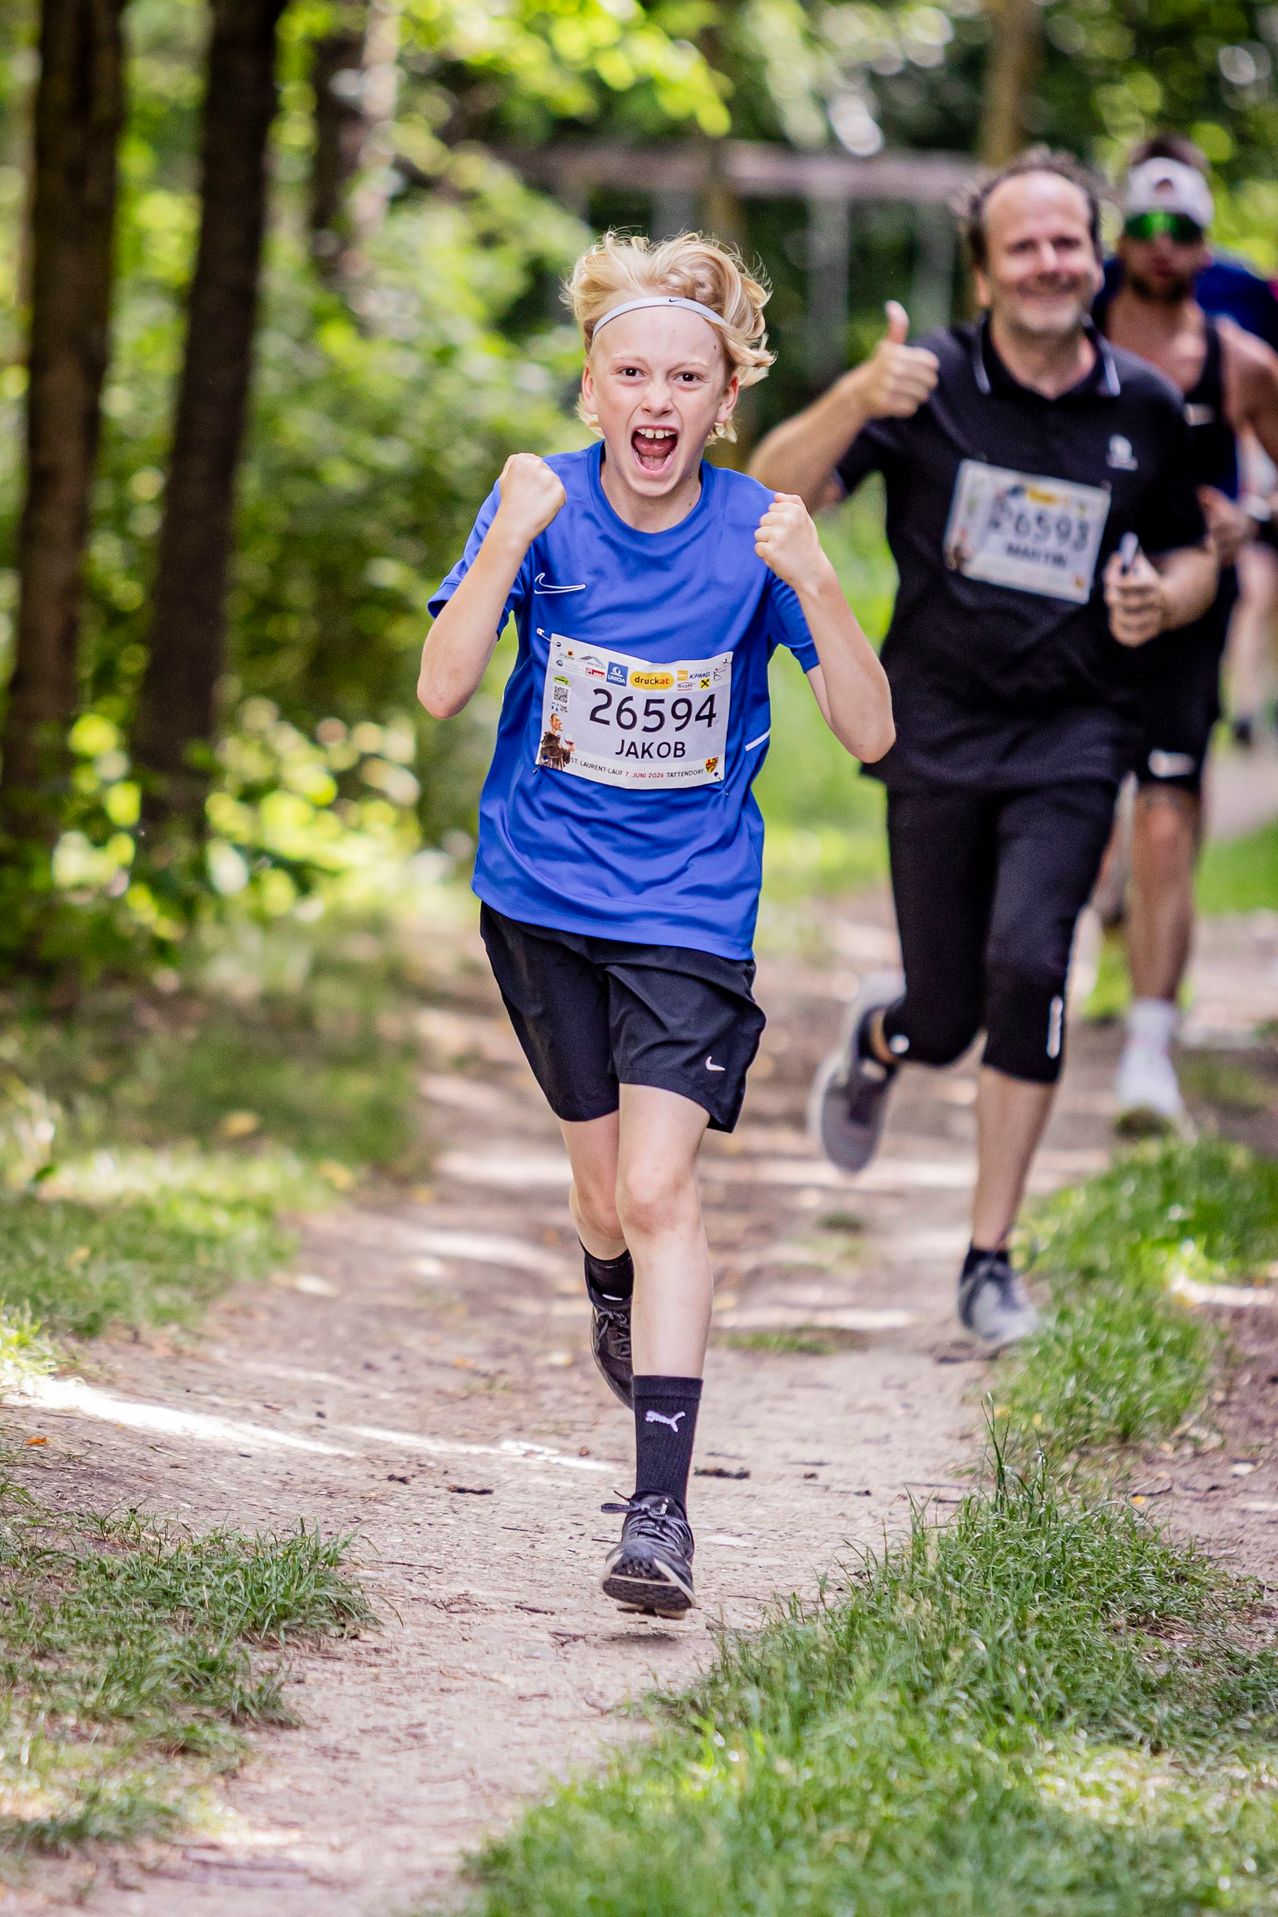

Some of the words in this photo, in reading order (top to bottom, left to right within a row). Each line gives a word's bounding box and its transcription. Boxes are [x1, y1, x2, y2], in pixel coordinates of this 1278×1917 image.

[634, 676, 670, 685] druckat
[589, 688, 717, 733] 26594
[615, 739, 686, 759] JAKOB
[580, 760, 623, 776] LAURENT-LAUF
[667, 768, 704, 778] TATTENDORF
